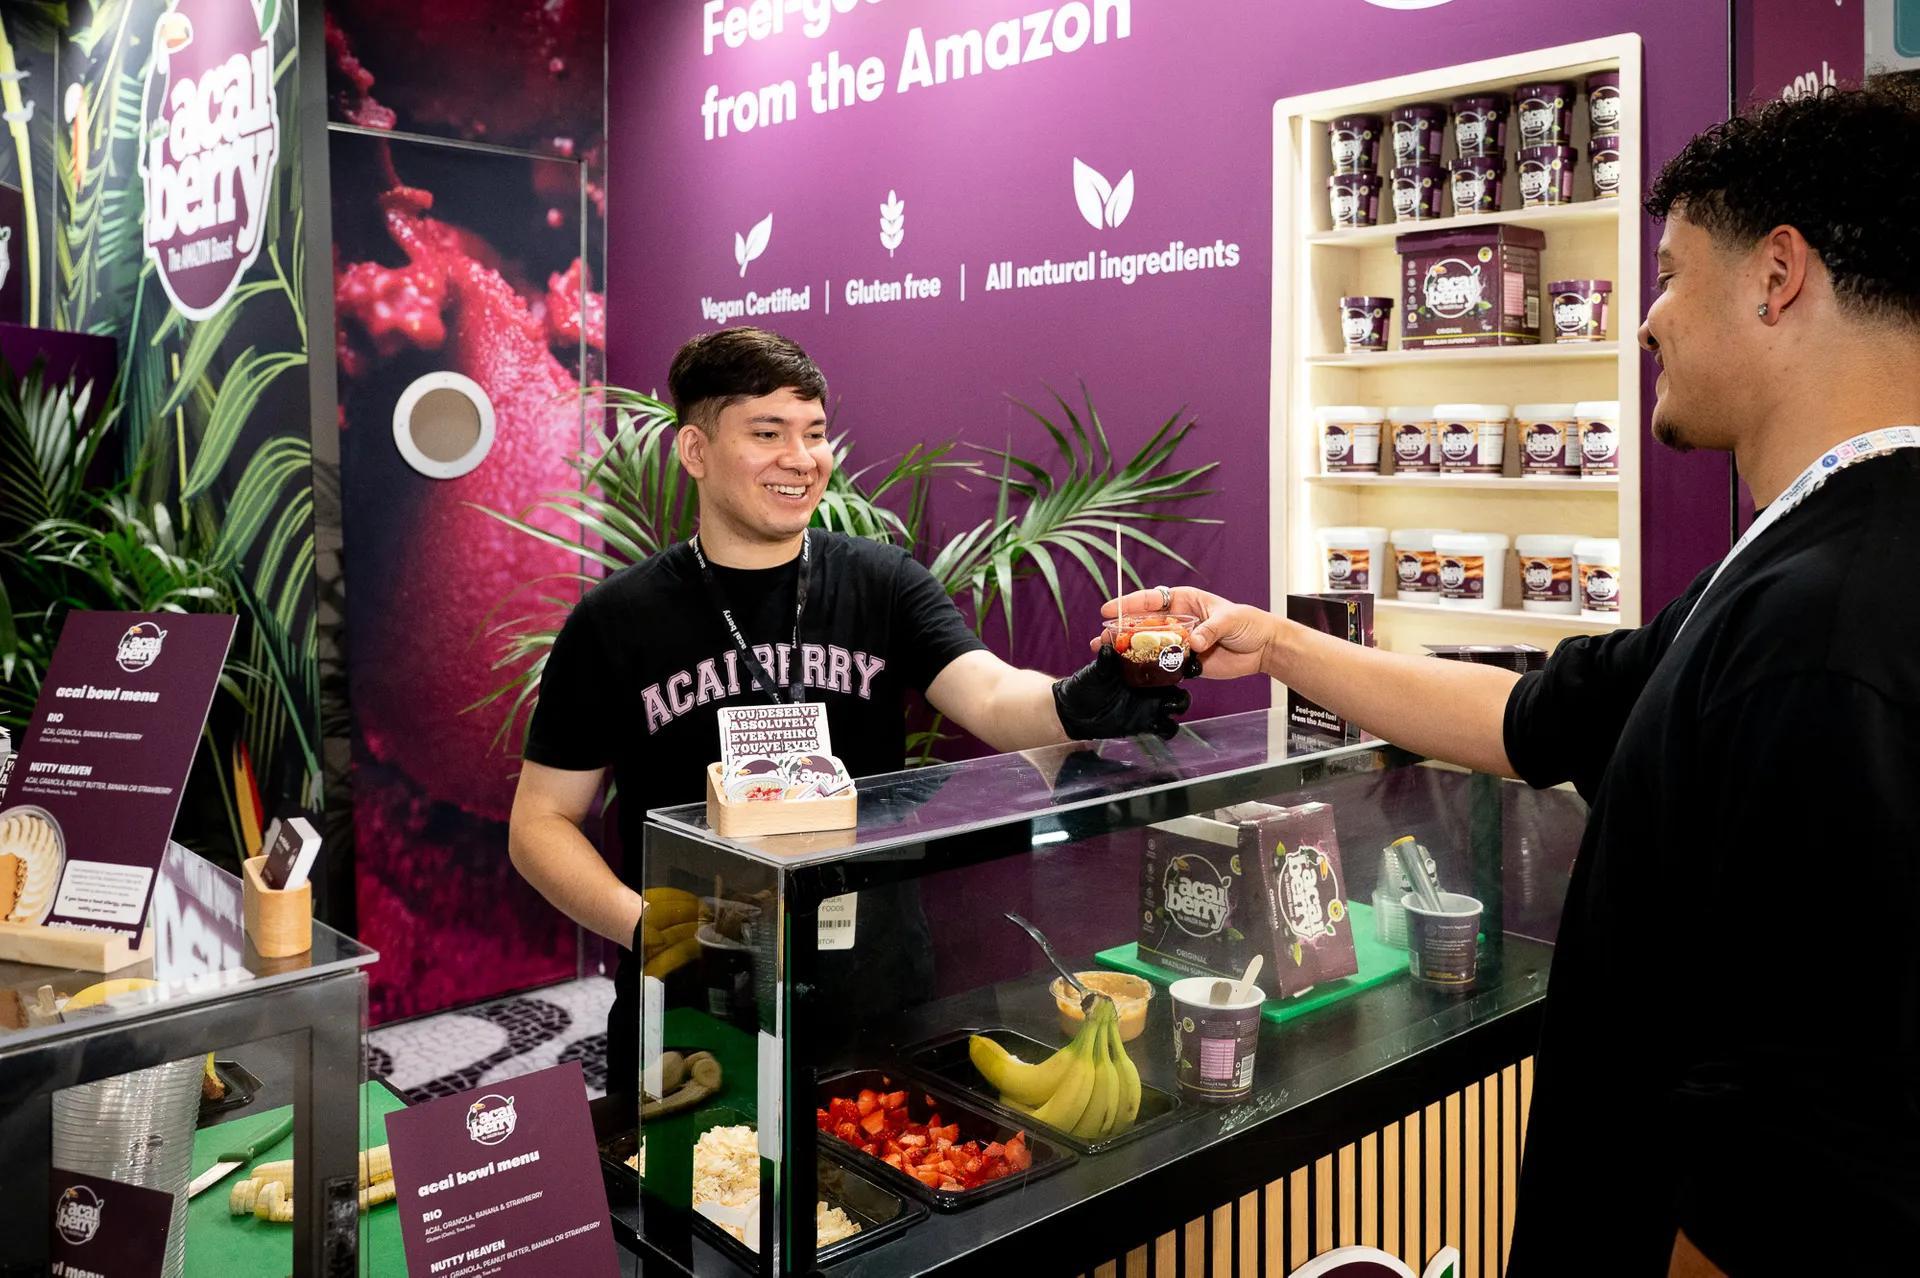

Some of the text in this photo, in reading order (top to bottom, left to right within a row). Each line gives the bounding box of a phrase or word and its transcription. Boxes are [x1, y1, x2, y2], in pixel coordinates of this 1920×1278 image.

[701, 0, 1131, 141] from the Amazon
[149, 128, 274, 253] berry
[984, 239, 1241, 291] All natural ingredients
[702, 285, 810, 324] Vegan Certified
[845, 273, 941, 305] Gluten free
[722, 609, 747, 650] acai berry
[56, 684, 160, 703] acai bowl menu
[640, 649, 741, 735] ACAI
[46, 712, 64, 723] RIO
[727, 706, 819, 720] YOU DESERVE
[731, 717, 815, 731] ABSOLUTELY
[1291, 713, 1341, 732] from the Amazon
[1295, 705, 1337, 721] Feel-good fuel
[731, 728, 817, 742] EVERYTHING
[784, 739, 819, 751] EVER
[29, 762, 93, 776] NUTTY HEAVEN
[1168, 883, 1227, 929] berry
[1178, 877, 1225, 907] acai
[1289, 855, 1313, 937] berry
[1269, 888, 1279, 929] ORIGINAL
[1176, 948, 1207, 965] ORIGINAL
[471, 1116, 516, 1138] berry
[418, 1150, 540, 1198] acai bowl menu
[59, 1207, 98, 1238] berry
[422, 1209, 442, 1223] RIO
[425, 1190, 544, 1236] ACAI, GRANOLA, BANANA & STRAWBERRY
[430, 1239, 506, 1274] NUTTY HEAVEN
[482, 1253, 506, 1268] PEANUT
[506, 1246, 531, 1260] BUTTER,
[531, 1238, 554, 1251] BANANA
[554, 1233, 565, 1242] OR
[564, 1220, 601, 1240] STRAWBERRY
